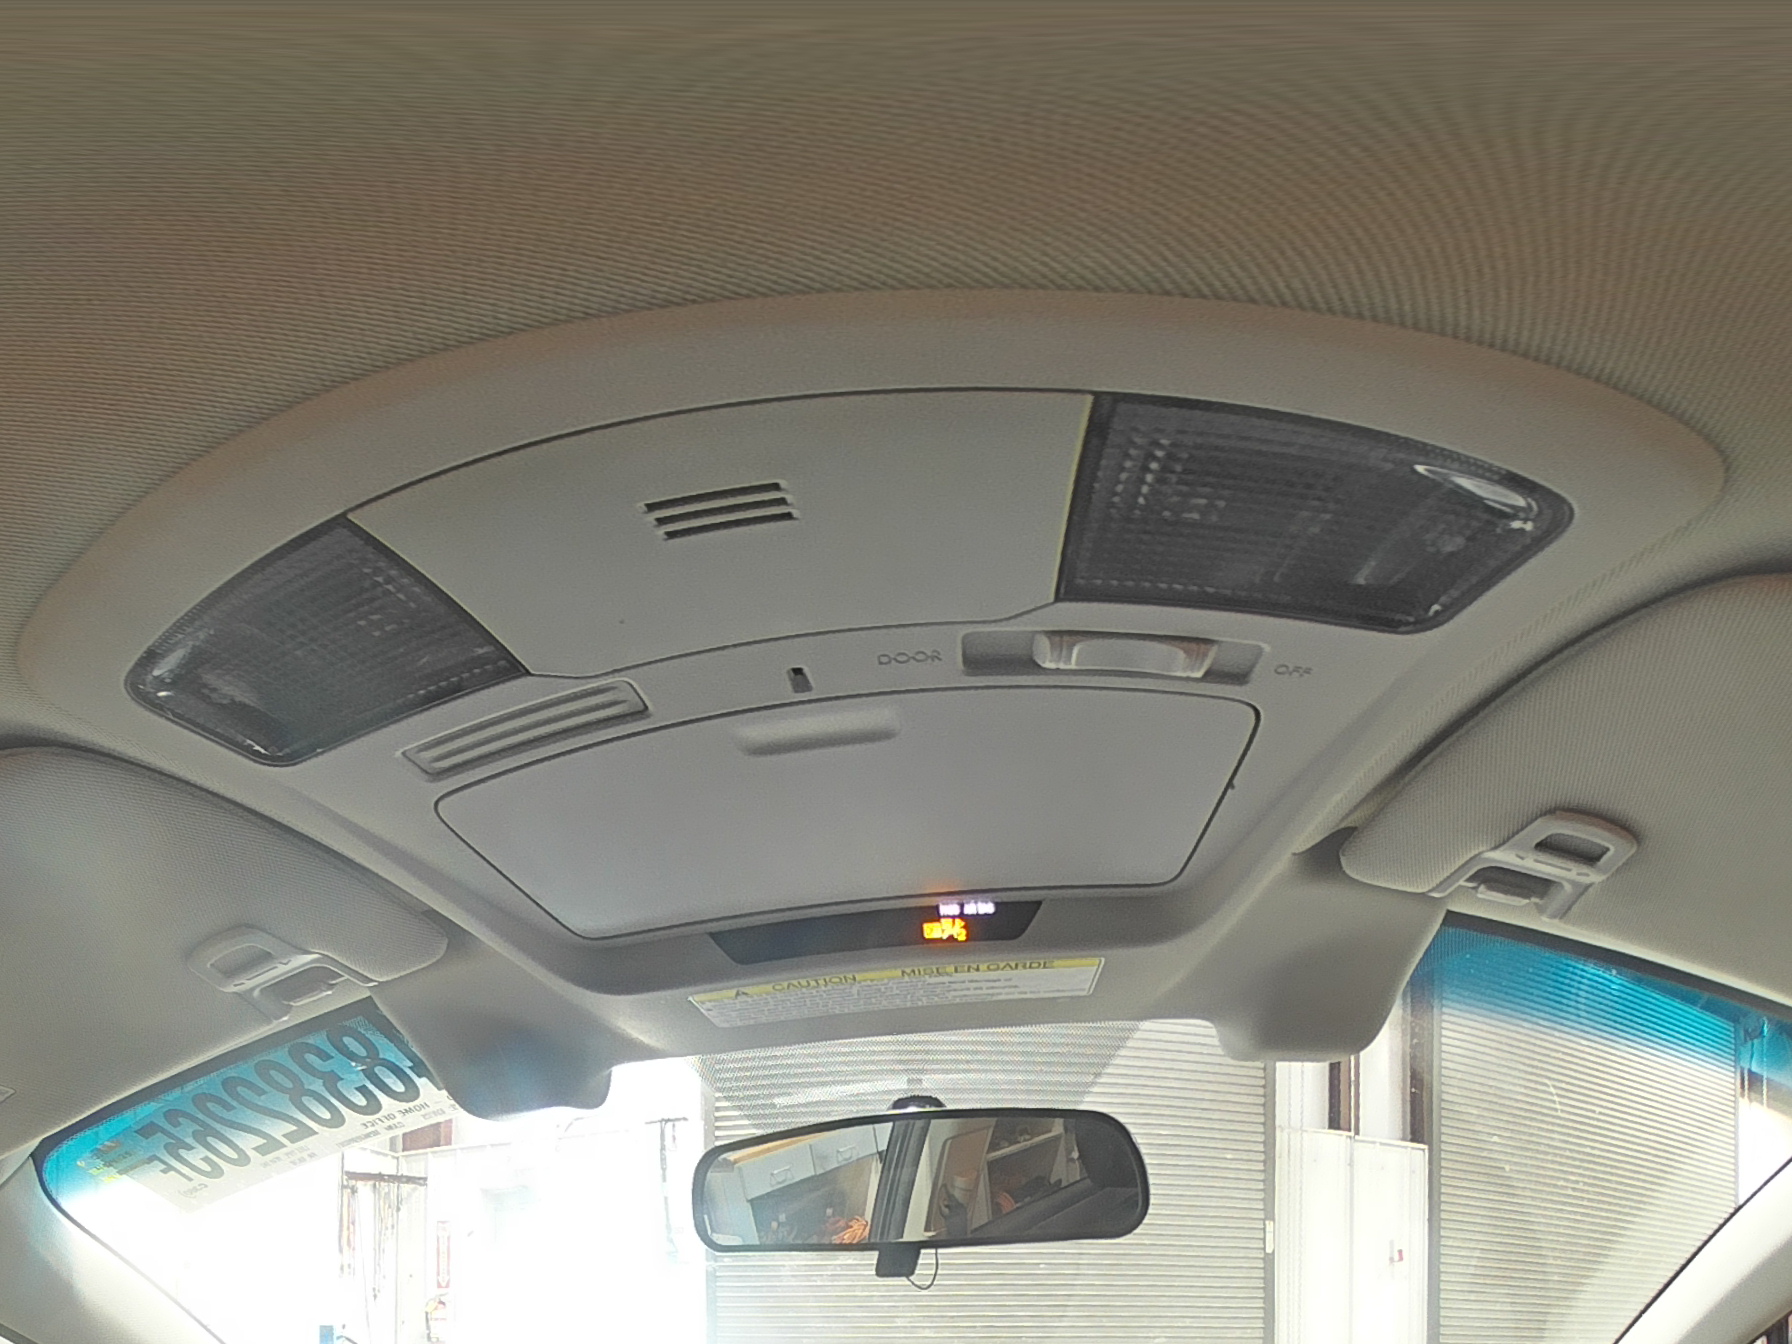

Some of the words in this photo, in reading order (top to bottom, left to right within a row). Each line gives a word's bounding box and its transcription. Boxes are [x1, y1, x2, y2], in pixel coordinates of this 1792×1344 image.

[877, 650, 943, 665] DOOR
[1274, 664, 1312, 677] OFF
[901, 967, 947, 977] MISE
[954, 963, 979, 973] EN
[987, 960, 1054, 971] GARDE
[771, 974, 857, 993] CAUTION
